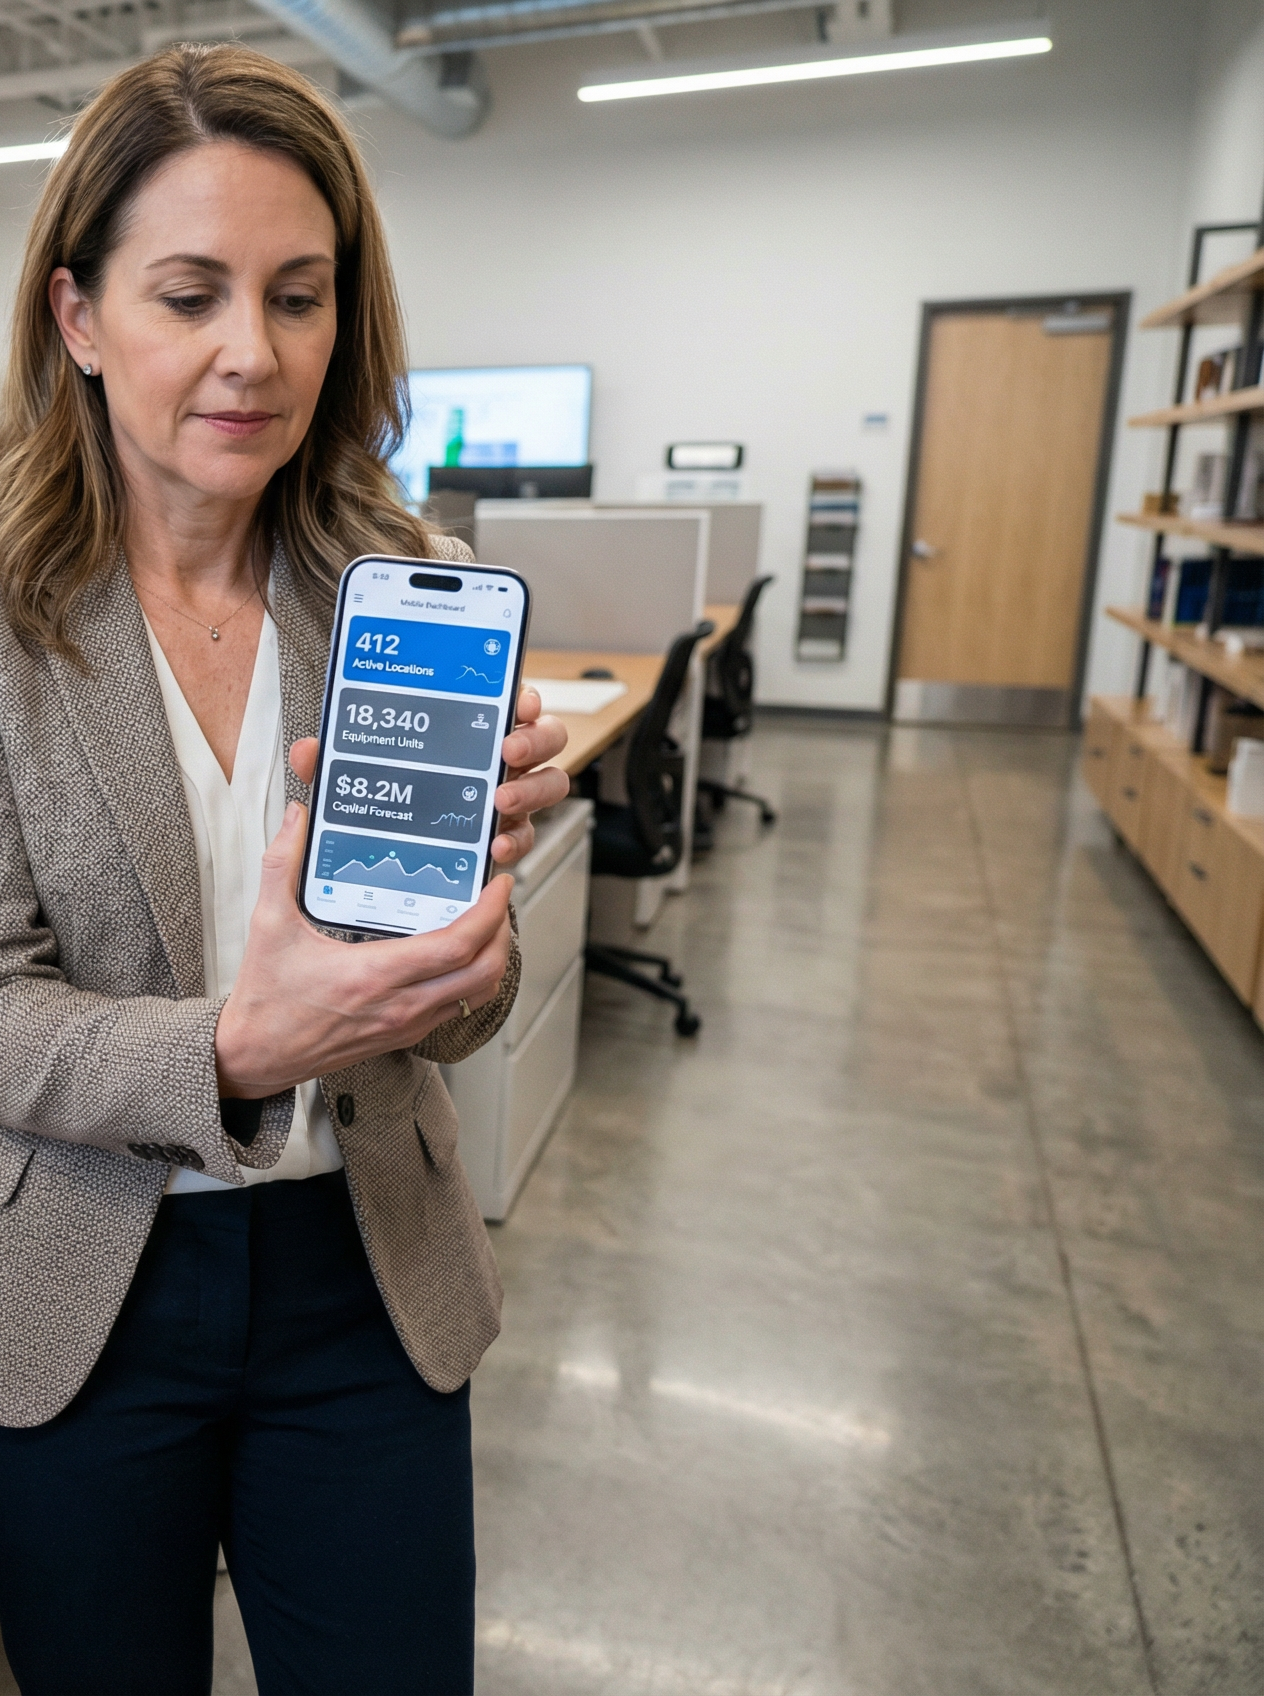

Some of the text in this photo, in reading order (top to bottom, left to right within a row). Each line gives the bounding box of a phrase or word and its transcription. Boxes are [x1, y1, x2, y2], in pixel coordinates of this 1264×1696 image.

[355, 632, 401, 656] 412
[352, 657, 435, 677] Active Locations
[346, 703, 430, 733] 18,340
[342, 730, 425, 750] Equipment Units
[335, 773, 414, 805] $8.2M
[369, 805, 414, 822] Forecast
